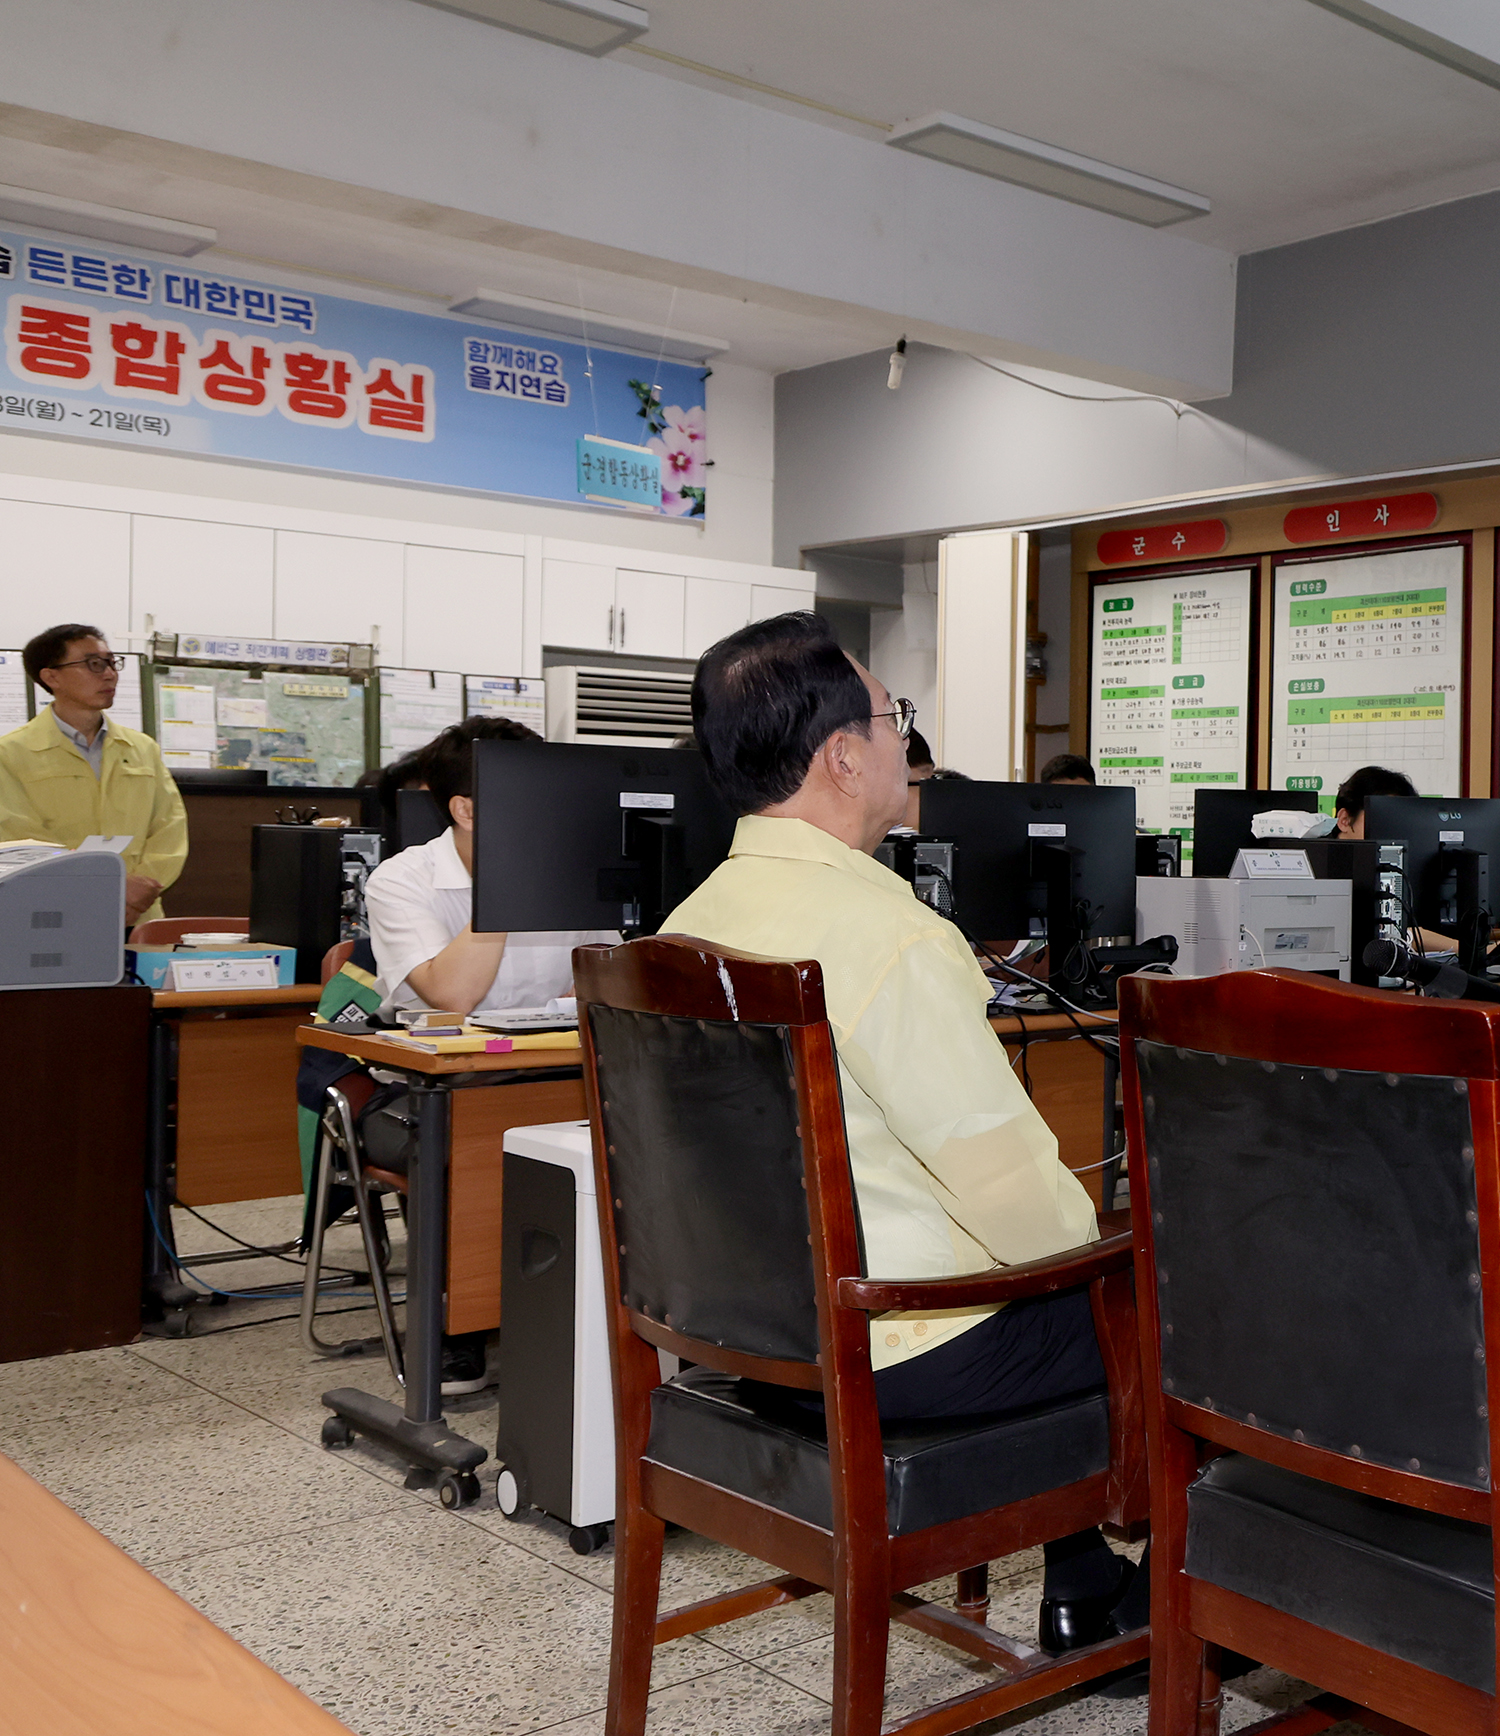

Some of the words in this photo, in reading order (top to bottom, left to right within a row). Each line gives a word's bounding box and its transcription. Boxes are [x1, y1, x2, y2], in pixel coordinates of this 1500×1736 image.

[28, 247, 150, 300] 든든한
[165, 274, 312, 330] 대한민국
[18, 305, 426, 433] 종합상황실
[468, 341, 559, 375] 함께해요
[469, 364, 566, 403] 을지연습
[89, 407, 170, 436] 21일(목)
